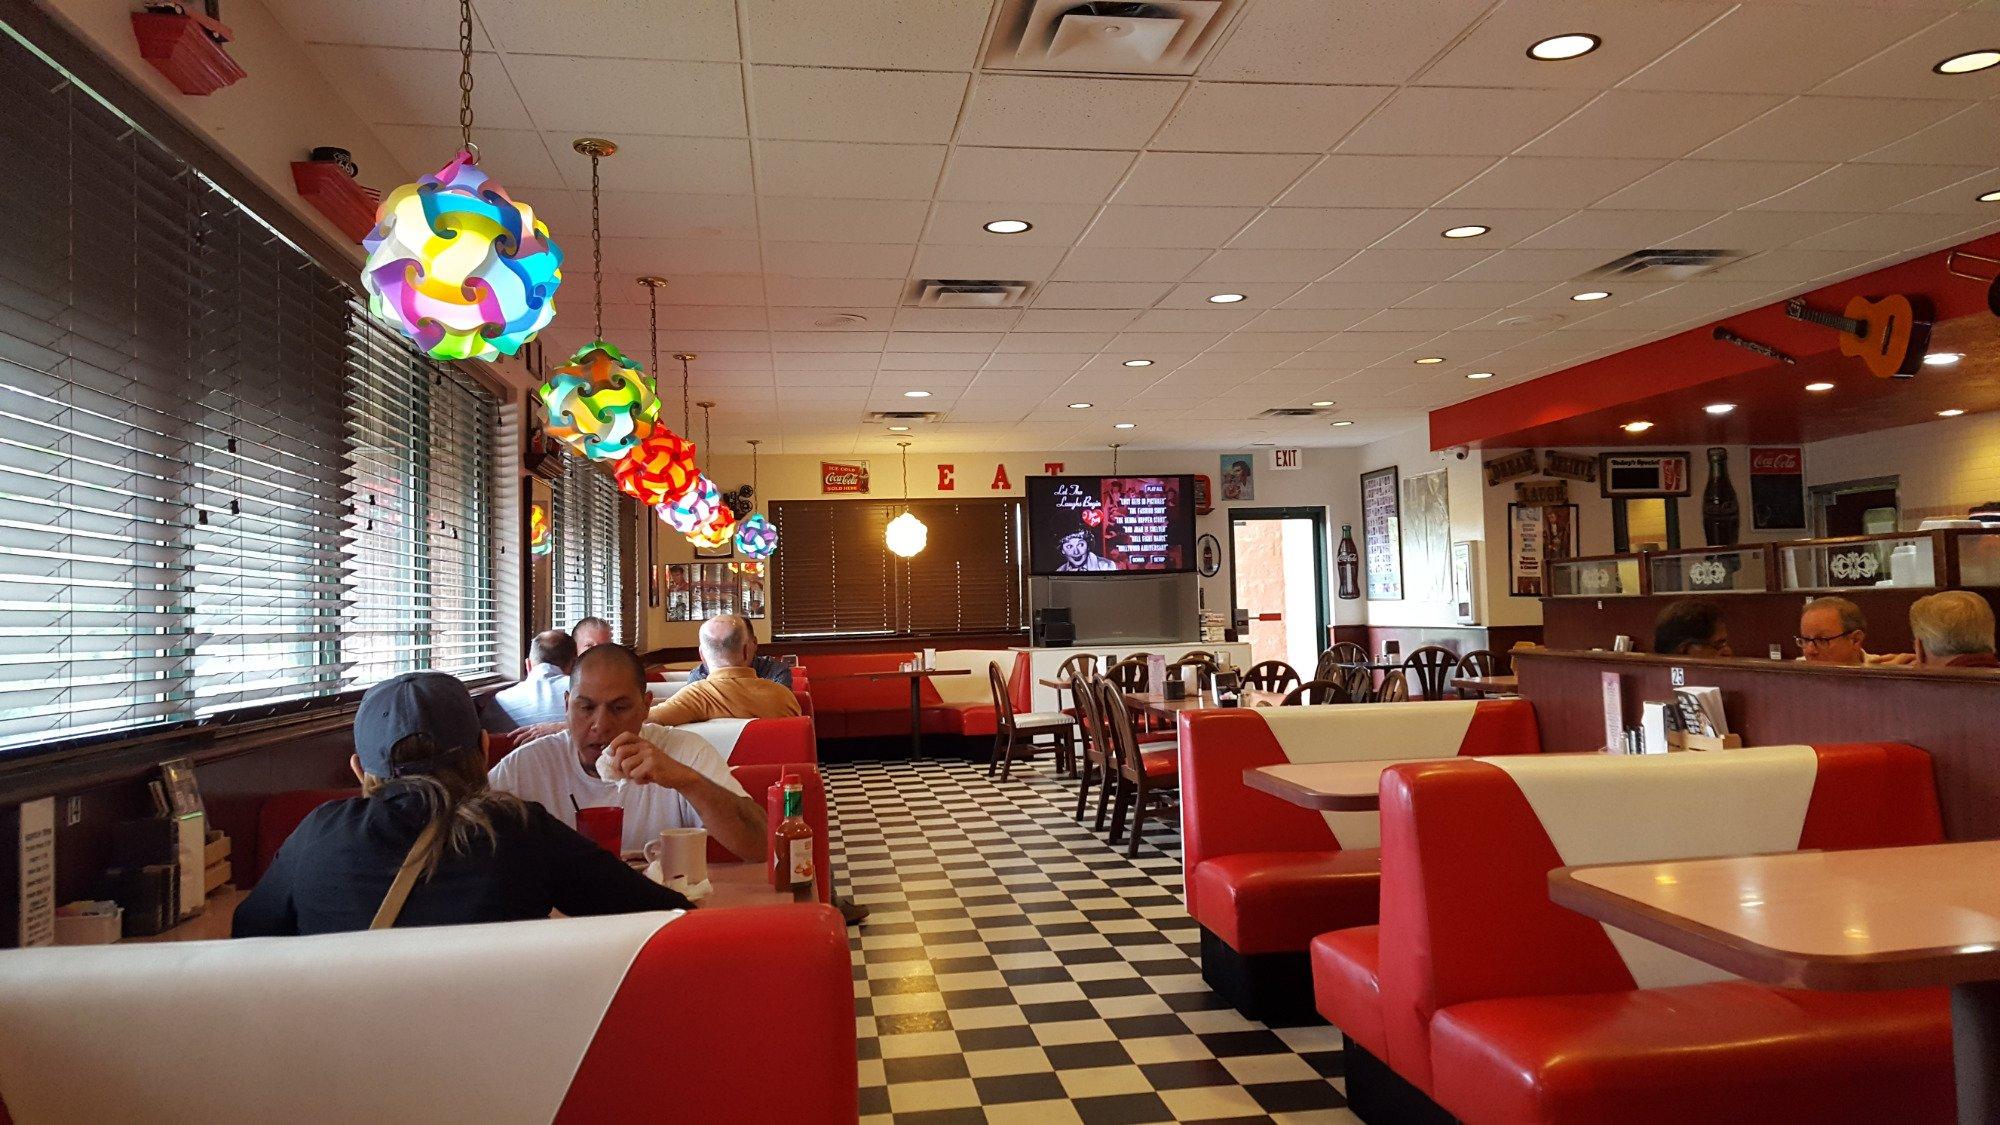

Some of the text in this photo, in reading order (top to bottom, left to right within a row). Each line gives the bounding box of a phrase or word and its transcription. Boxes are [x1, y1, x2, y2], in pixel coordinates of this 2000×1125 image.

[1276, 450, 1297, 466] EXIT
[1054, 484, 1083, 495] Let The
[1056, 496, 1101, 510] Laughs Begin
[1672, 669, 1684, 684] 25
